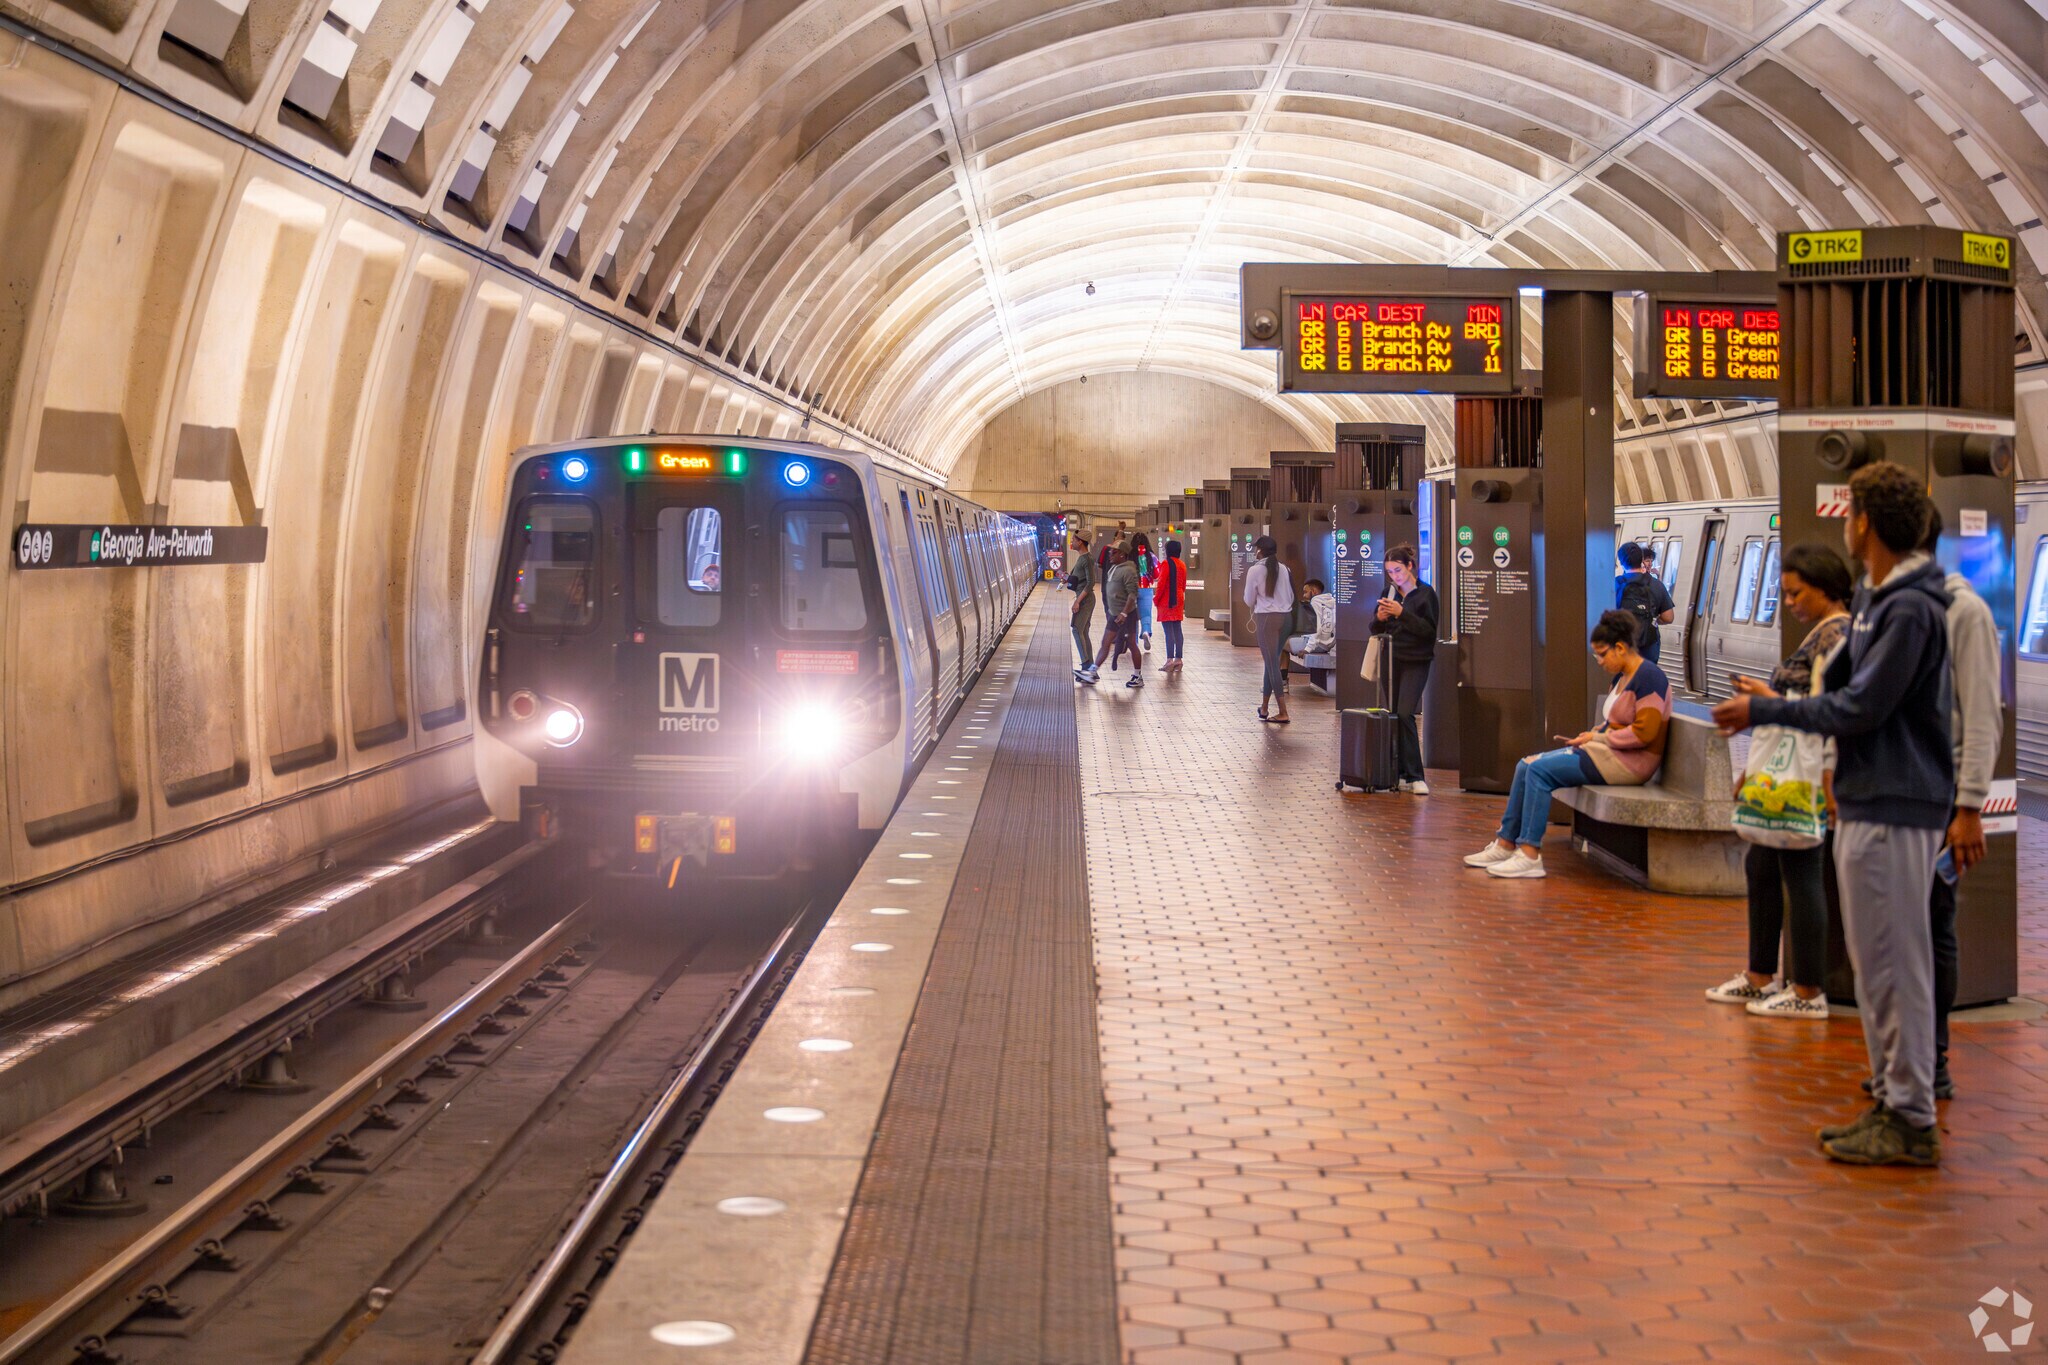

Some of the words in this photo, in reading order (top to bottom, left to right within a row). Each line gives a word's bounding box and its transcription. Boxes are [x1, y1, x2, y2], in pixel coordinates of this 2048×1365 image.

[1815, 238, 1857, 254] TRK2
[1968, 241, 1992, 259] TRK1
[1299, 304, 1324, 321] LN
[1333, 305, 1368, 322] CAR
[1379, 305, 1425, 322] DEST
[1468, 306, 1500, 323] MIN
[1665, 310, 1690, 327] LN
[1698, 310, 1734, 328] CAR
[1743, 311, 1779, 329] DES
[1300, 321, 1326, 338] GR
[1338, 322, 1351, 338] 6
[1362, 322, 1422, 339] Branch
[1426, 322, 1451, 339] Av
[1464, 323, 1501, 339] BRD
[1665, 327, 1690, 343] GR
[1702, 328, 1716, 344] 6
[1727, 328, 1779, 345] Green
[1300, 338, 1326, 354] GR
[1338, 338, 1351, 355] 6
[1362, 338, 1422, 355] Branch
[1426, 338, 1451, 356] Av
[1487, 339, 1501, 356] 7
[1665, 343, 1690, 360] GR
[1702, 344, 1716, 360] 6
[1727, 345, 1779, 362] Green
[1300, 354, 1326, 370] GR
[1338, 354, 1351, 371] 6
[1362, 355, 1422, 371] Branch
[1426, 355, 1451, 372] Av
[1484, 355, 1501, 373] 11
[1665, 360, 1690, 377] GR
[1702, 360, 1716, 377] 6
[1727, 361, 1779, 379] Green
[1808, 418, 1854, 429] Emergency
[1856, 418, 1895, 427] Intercom
[660, 453, 710, 468] Green
[1833, 488, 1851, 501] HE
[1459, 531, 1471, 540] GR
[1495, 532, 1508, 541] GR
[101, 526, 144, 565] Georgia
[146, 528, 214, 558] Ave-Petworth
[664, 657, 715, 708] M
[659, 714, 719, 732] metro
